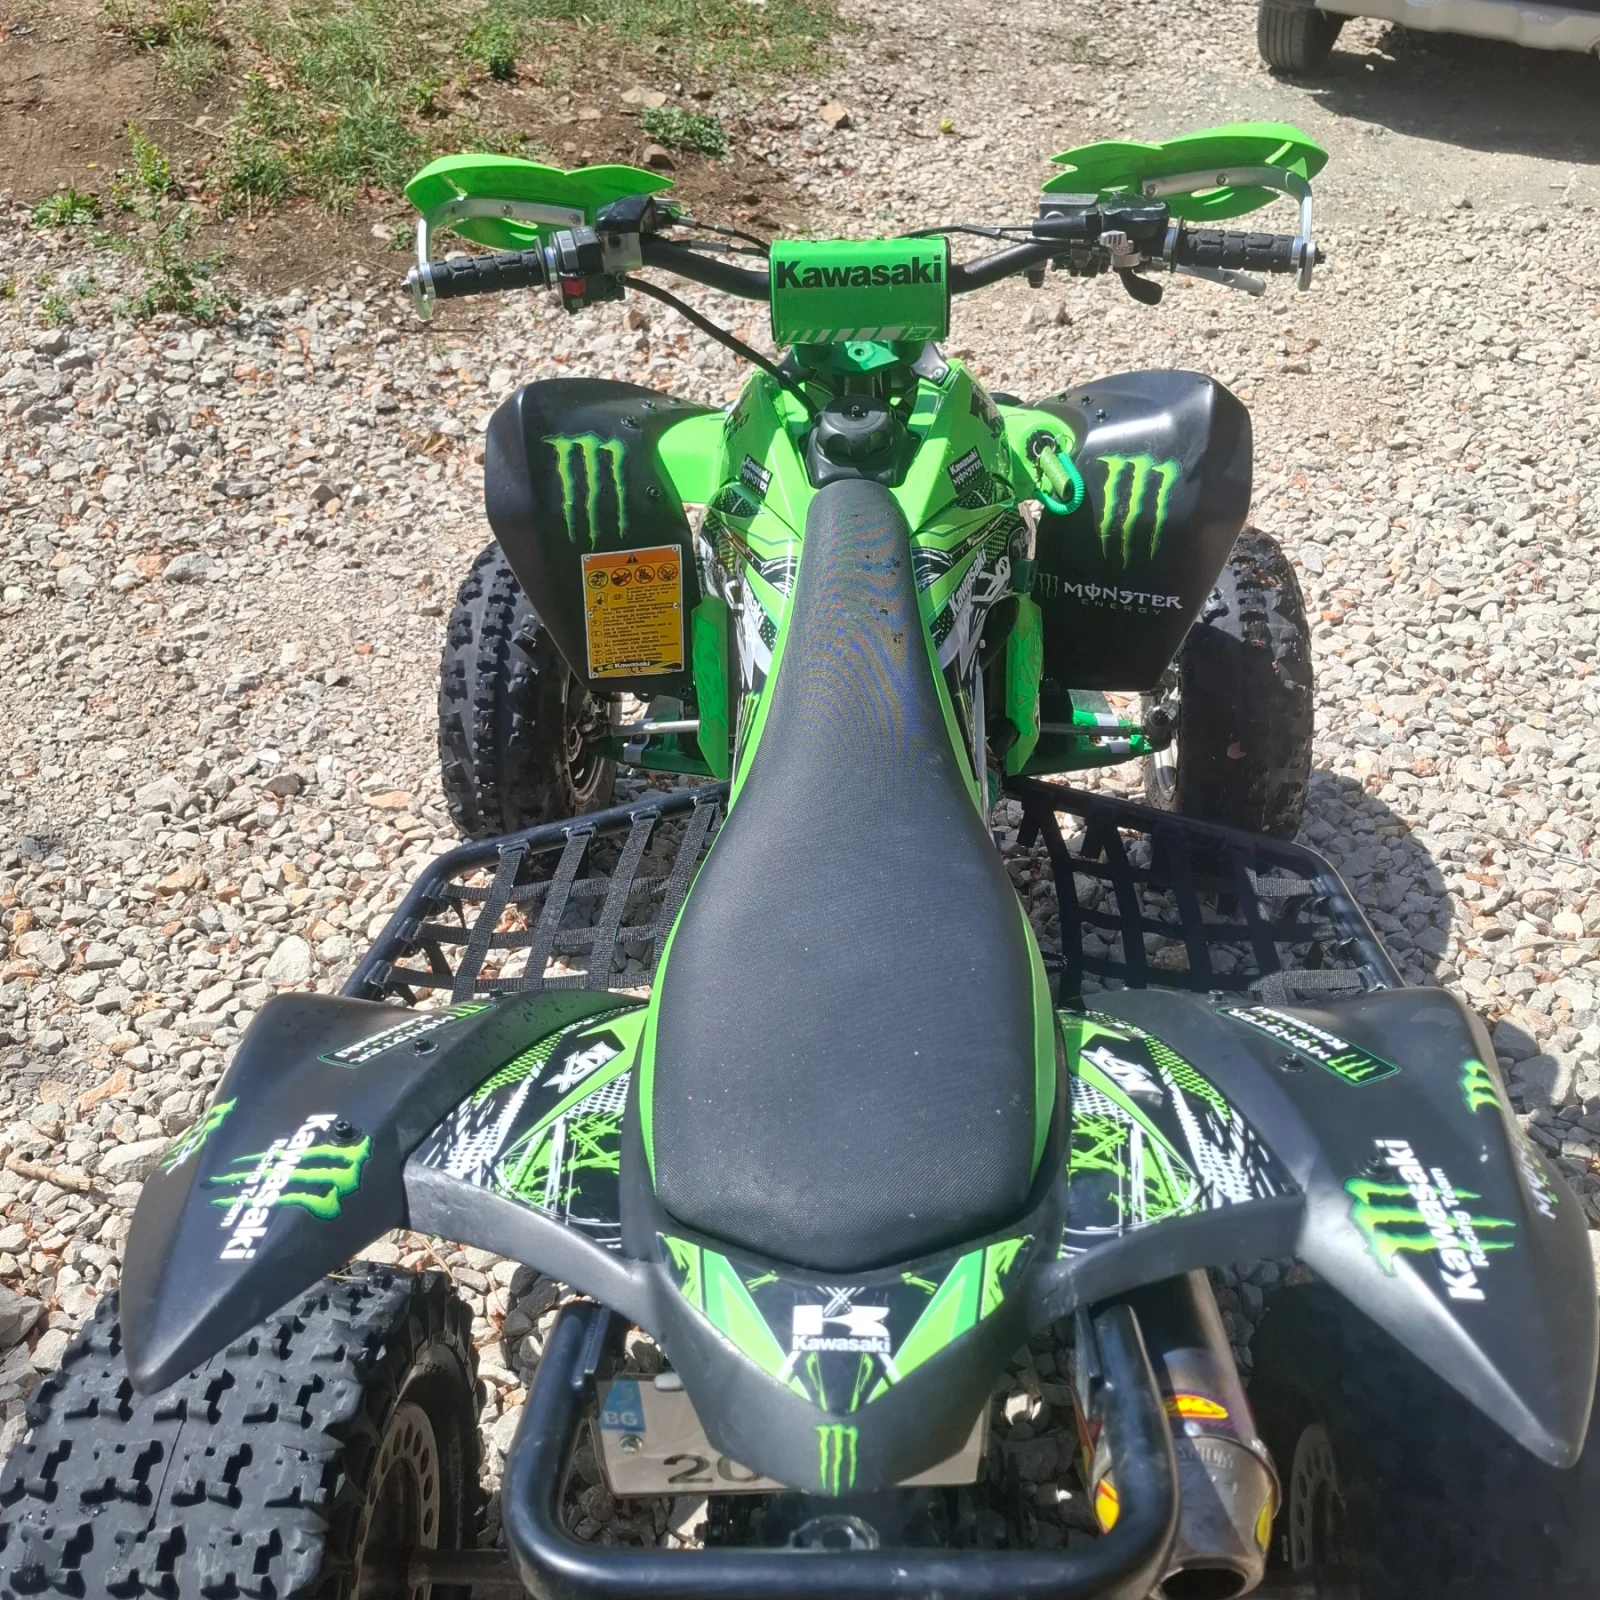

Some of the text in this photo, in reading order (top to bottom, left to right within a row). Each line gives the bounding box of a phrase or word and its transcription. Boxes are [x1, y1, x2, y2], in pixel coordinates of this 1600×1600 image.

[775, 254, 942, 289] Kawasaki
[949, 450, 979, 476] Kawasaki
[948, 549, 987, 618] Kawasaki
[1082, 600, 1162, 616] ENERGY
[614, 661, 651, 669] Kawasaki
[335, 1014, 433, 1058] Kawasaki
[1251, 1006, 1349, 1050] Kawasaki
[219, 1114, 338, 1259] Kawasaki
[221, 1138, 289, 1227] Racing Team
[1375, 1139, 1486, 1301] Kawasaki
[1428, 1167, 1490, 1267] Racing Team
[793, 1335, 892, 1353] Kawasaki
[603, 1410, 638, 1427] BG
